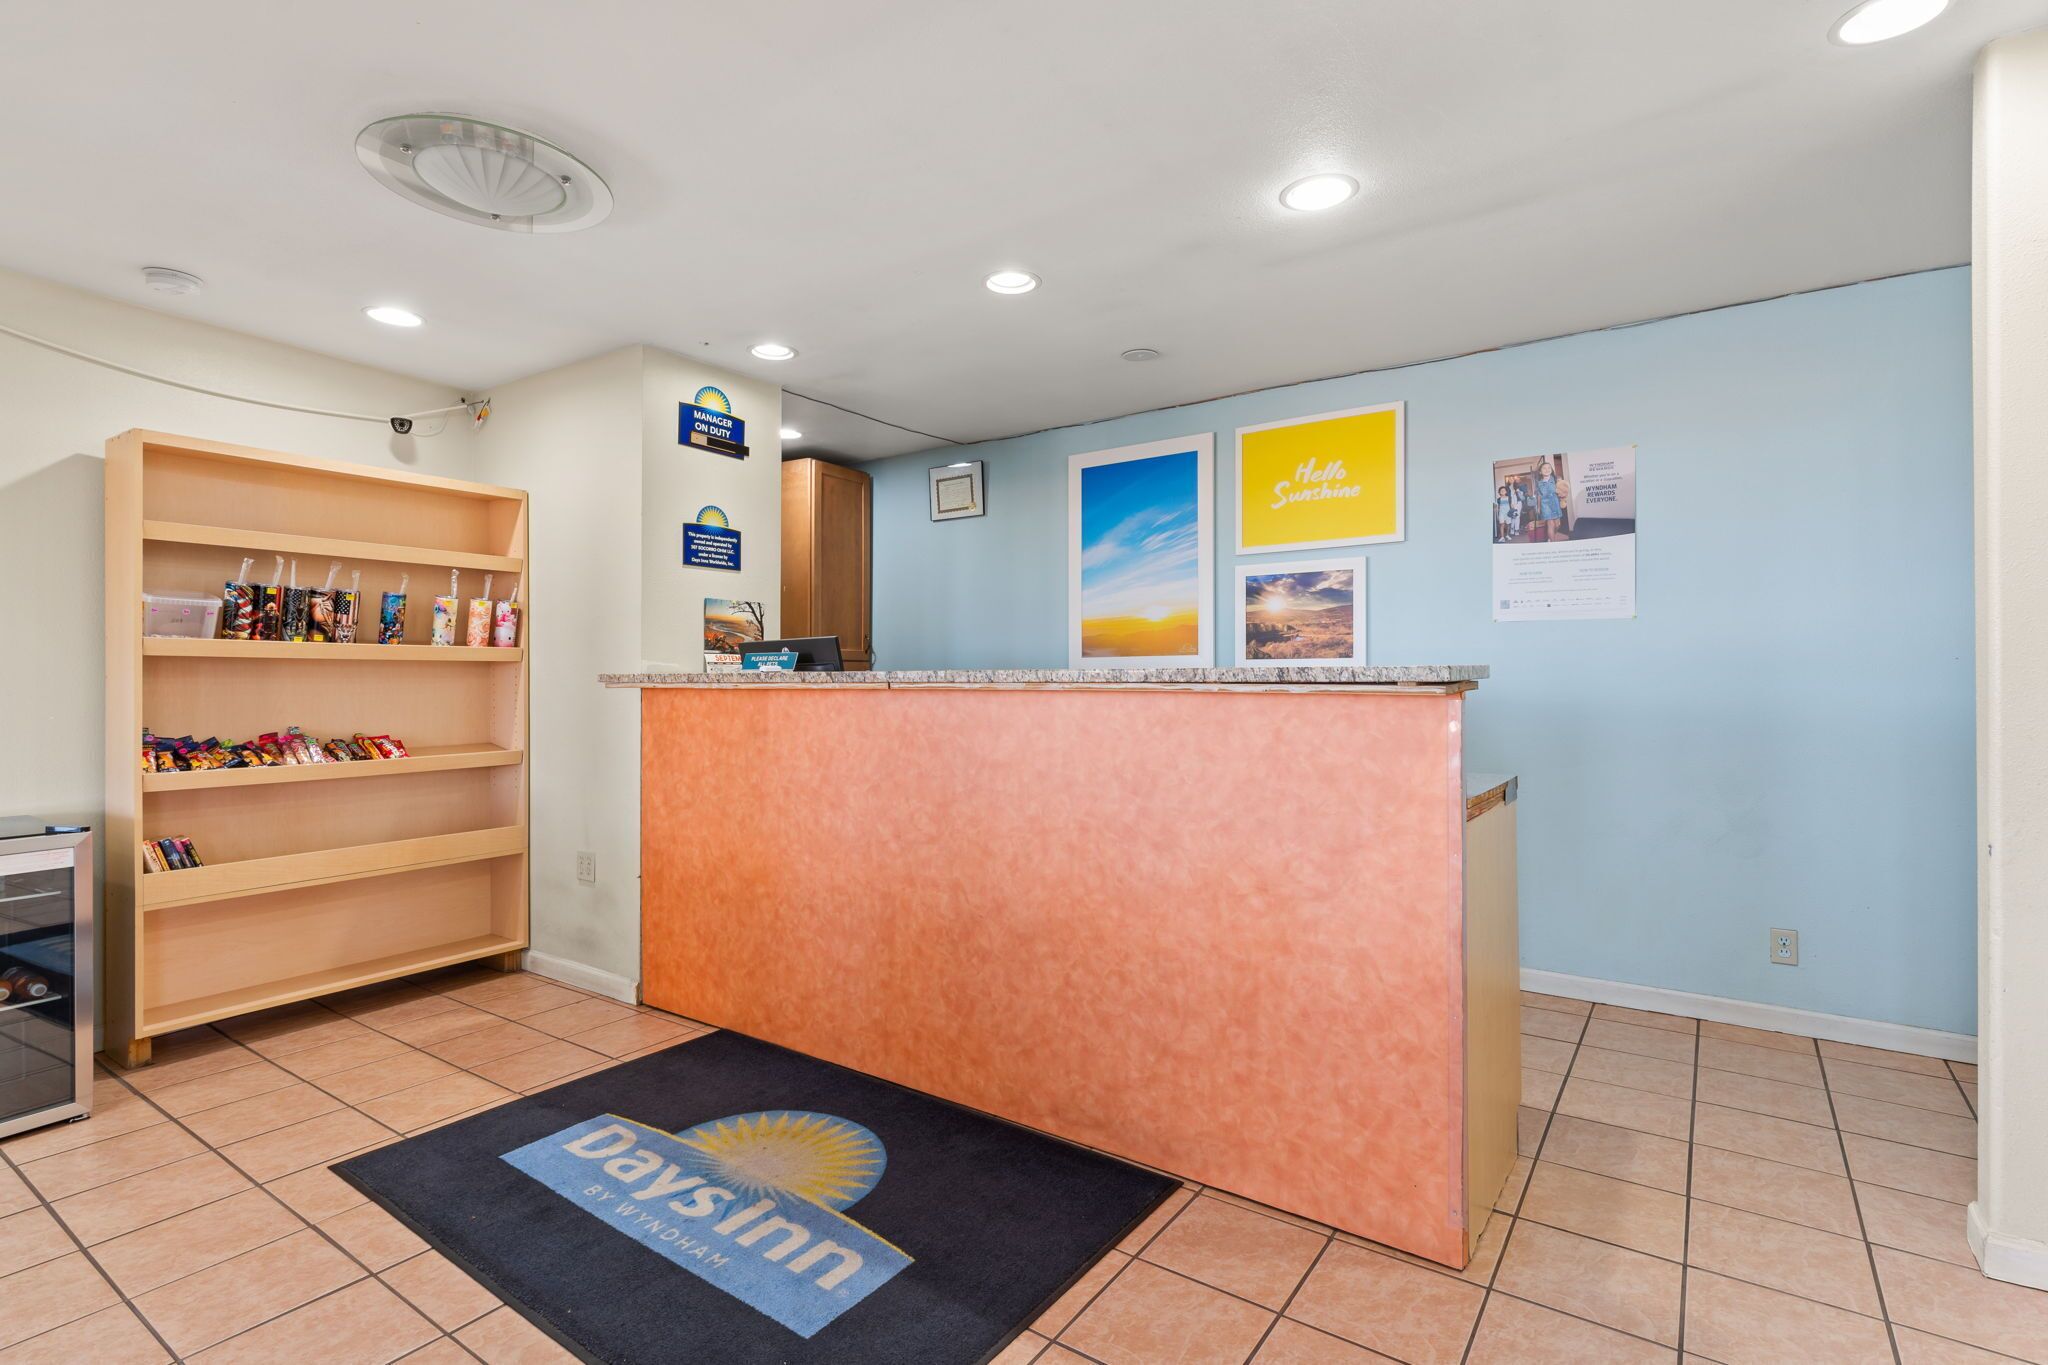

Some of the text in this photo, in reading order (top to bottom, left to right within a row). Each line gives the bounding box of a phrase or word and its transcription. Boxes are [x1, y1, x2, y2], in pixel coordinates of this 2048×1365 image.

[693, 410, 733, 428] MANAGER
[694, 422, 731, 439] ON DUTY
[1295, 456, 1347, 484] Hello
[1270, 481, 1361, 510] Sunshine
[1585, 496, 1618, 504] EVERYONE.
[583, 1184, 730, 1269] BY WYNDHAM
